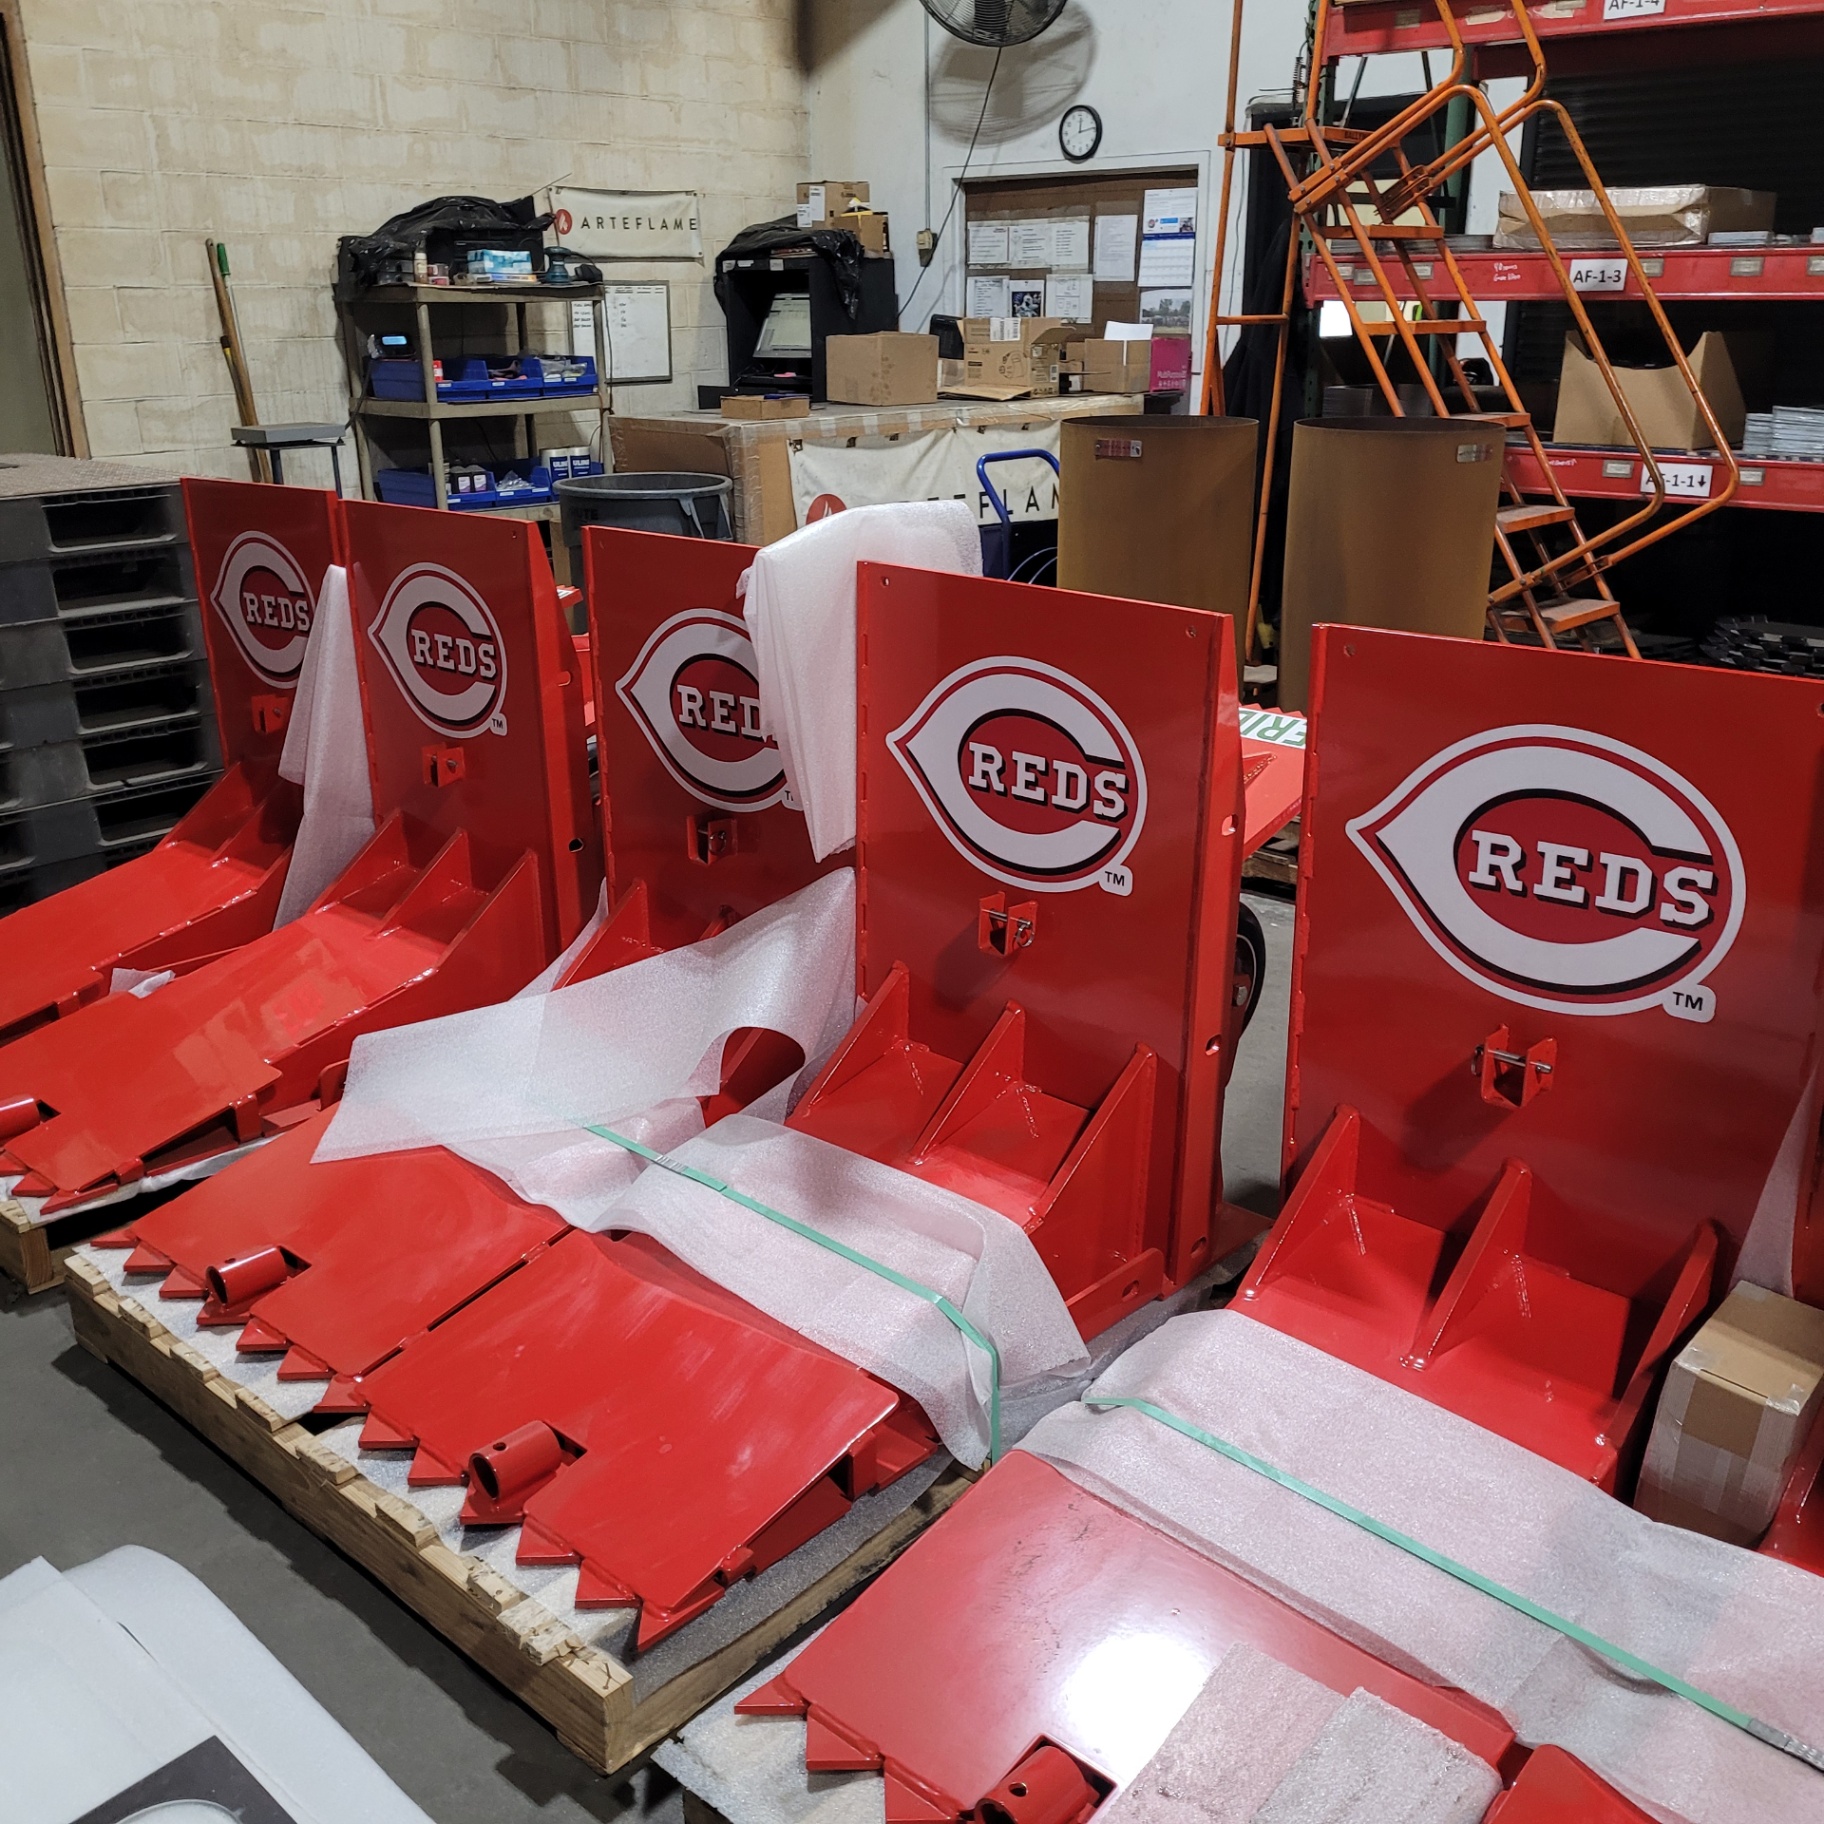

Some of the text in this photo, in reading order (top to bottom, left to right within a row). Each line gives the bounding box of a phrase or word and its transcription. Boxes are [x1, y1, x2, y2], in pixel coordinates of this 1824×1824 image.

[580, 216, 698, 231] ARTEFLAME
[1573, 269, 1622, 283] AF-1-3
[242, 592, 311, 633] REDS
[411, 628, 498, 681] REDS
[491, 717, 504, 730] TM
[677, 684, 776, 744] RED
[968, 741, 1129, 823] REDS
[1104, 870, 1125, 887] TM
[1467, 829, 1719, 931] REDS
[1671, 991, 1704, 1011] TM
